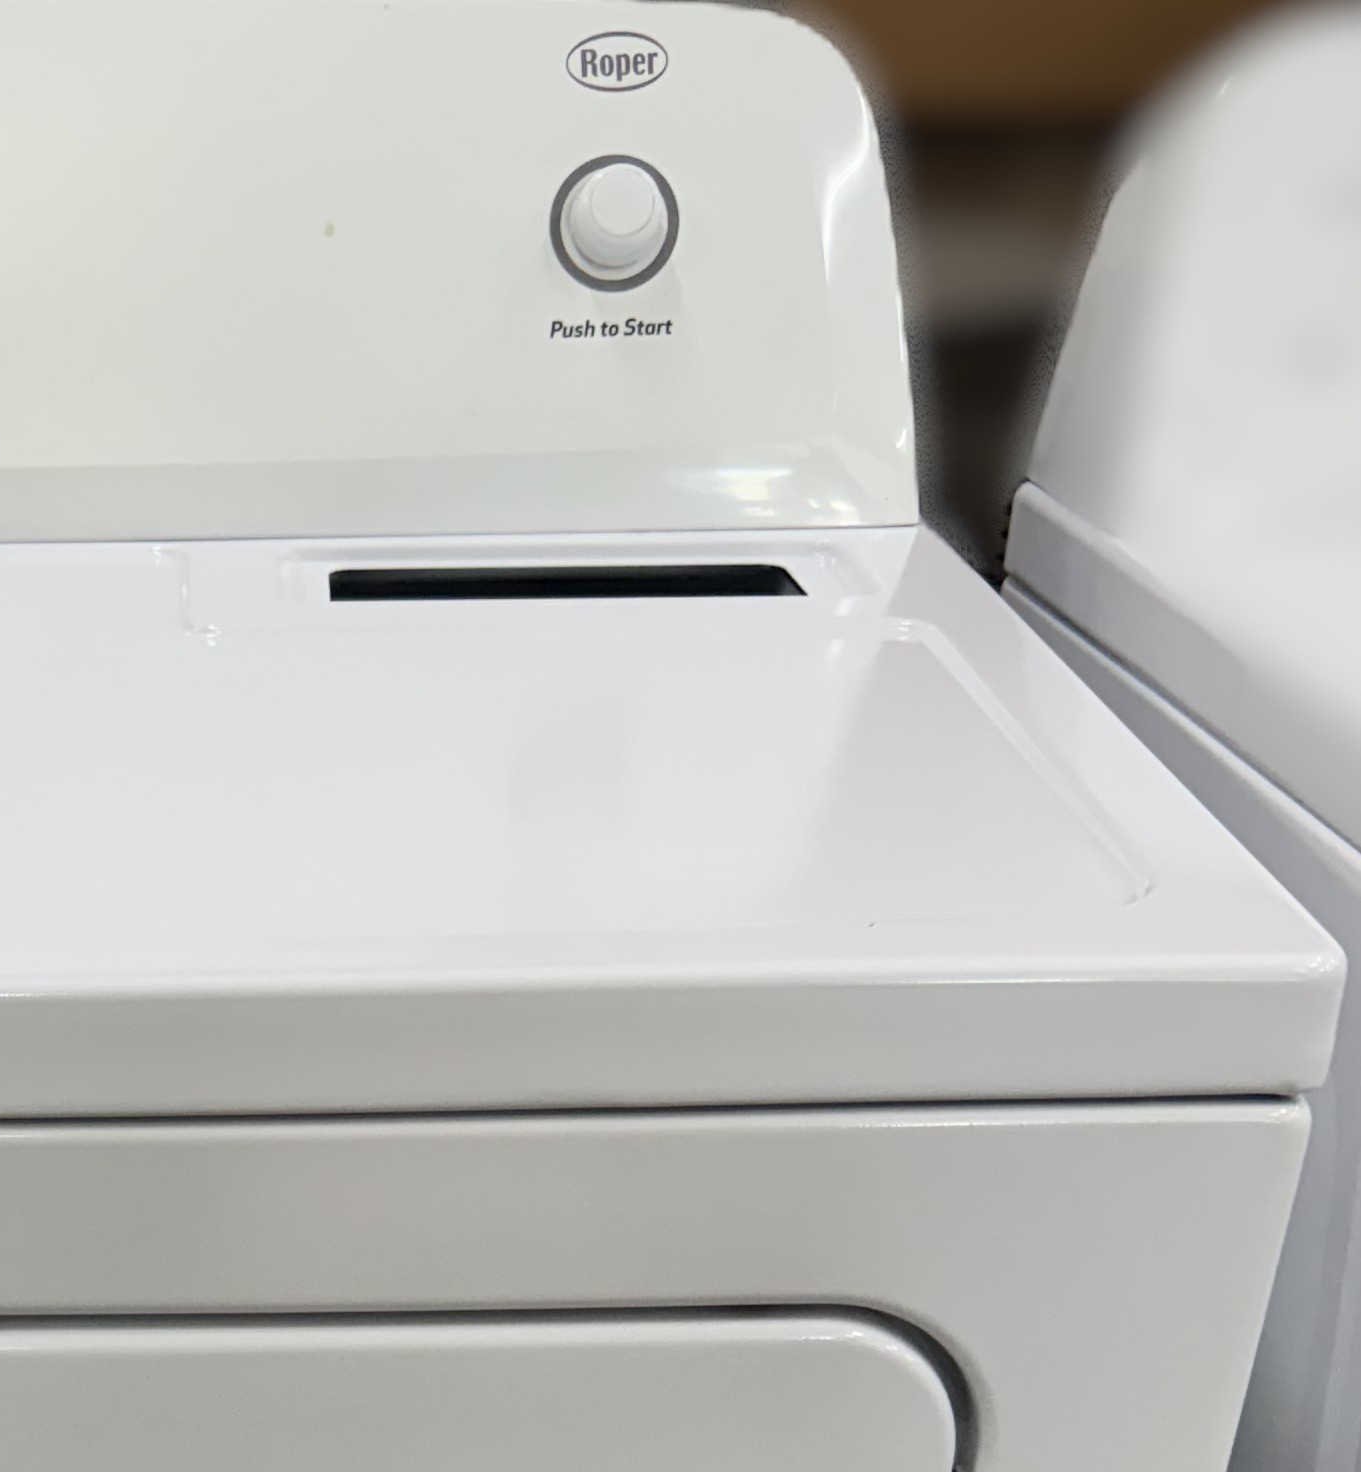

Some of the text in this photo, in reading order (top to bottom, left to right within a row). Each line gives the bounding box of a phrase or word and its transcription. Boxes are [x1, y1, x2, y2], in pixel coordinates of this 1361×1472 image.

[579, 49, 660, 82] Roper
[550, 318, 673, 338] Push to Start
